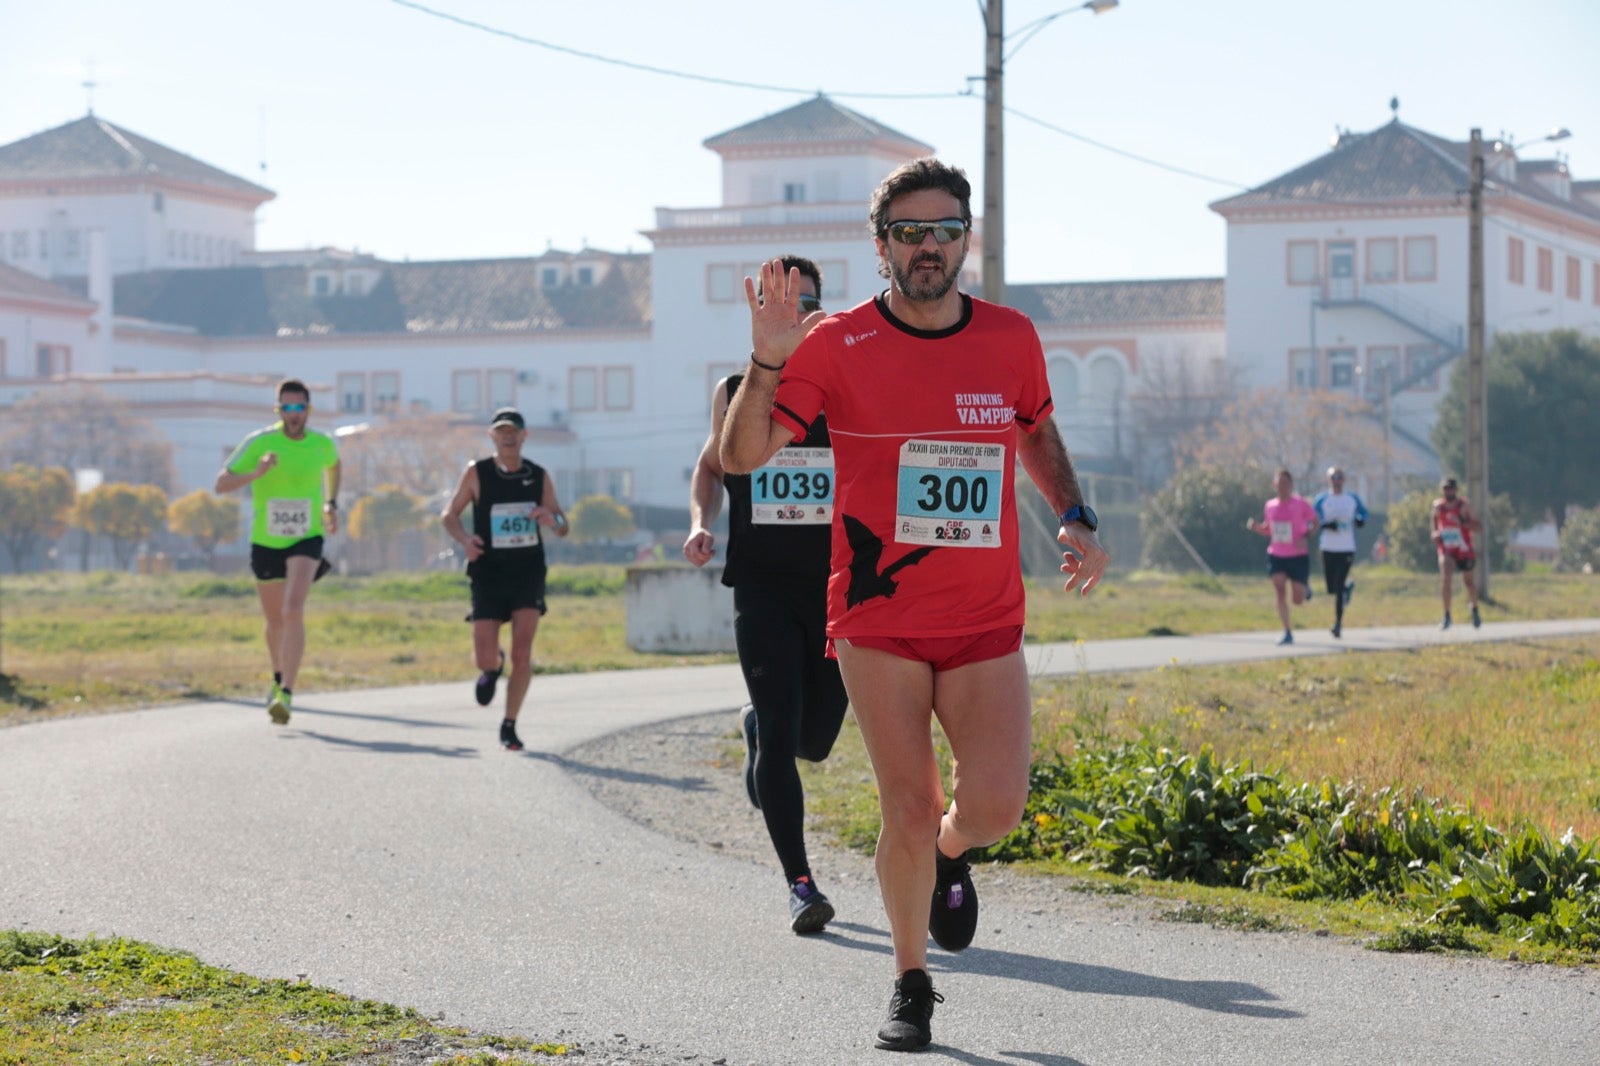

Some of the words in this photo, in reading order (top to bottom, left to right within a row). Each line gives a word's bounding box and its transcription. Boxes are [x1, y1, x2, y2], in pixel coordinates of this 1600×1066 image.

[955, 393, 1004, 406] RUNNING
[908, 442, 928, 454] XXXIII
[929, 443, 948, 455] GRAN
[949, 445, 974, 456] PREMIO
[975, 446, 983, 456] DE
[984, 447, 1001, 457] FONDO
[938, 456, 978, 468] DIPUTACIÓN
[756, 471, 830, 500] 1039
[917, 474, 988, 514] 300
[272, 511, 308, 525] 3045
[500, 516, 531, 533] 467
